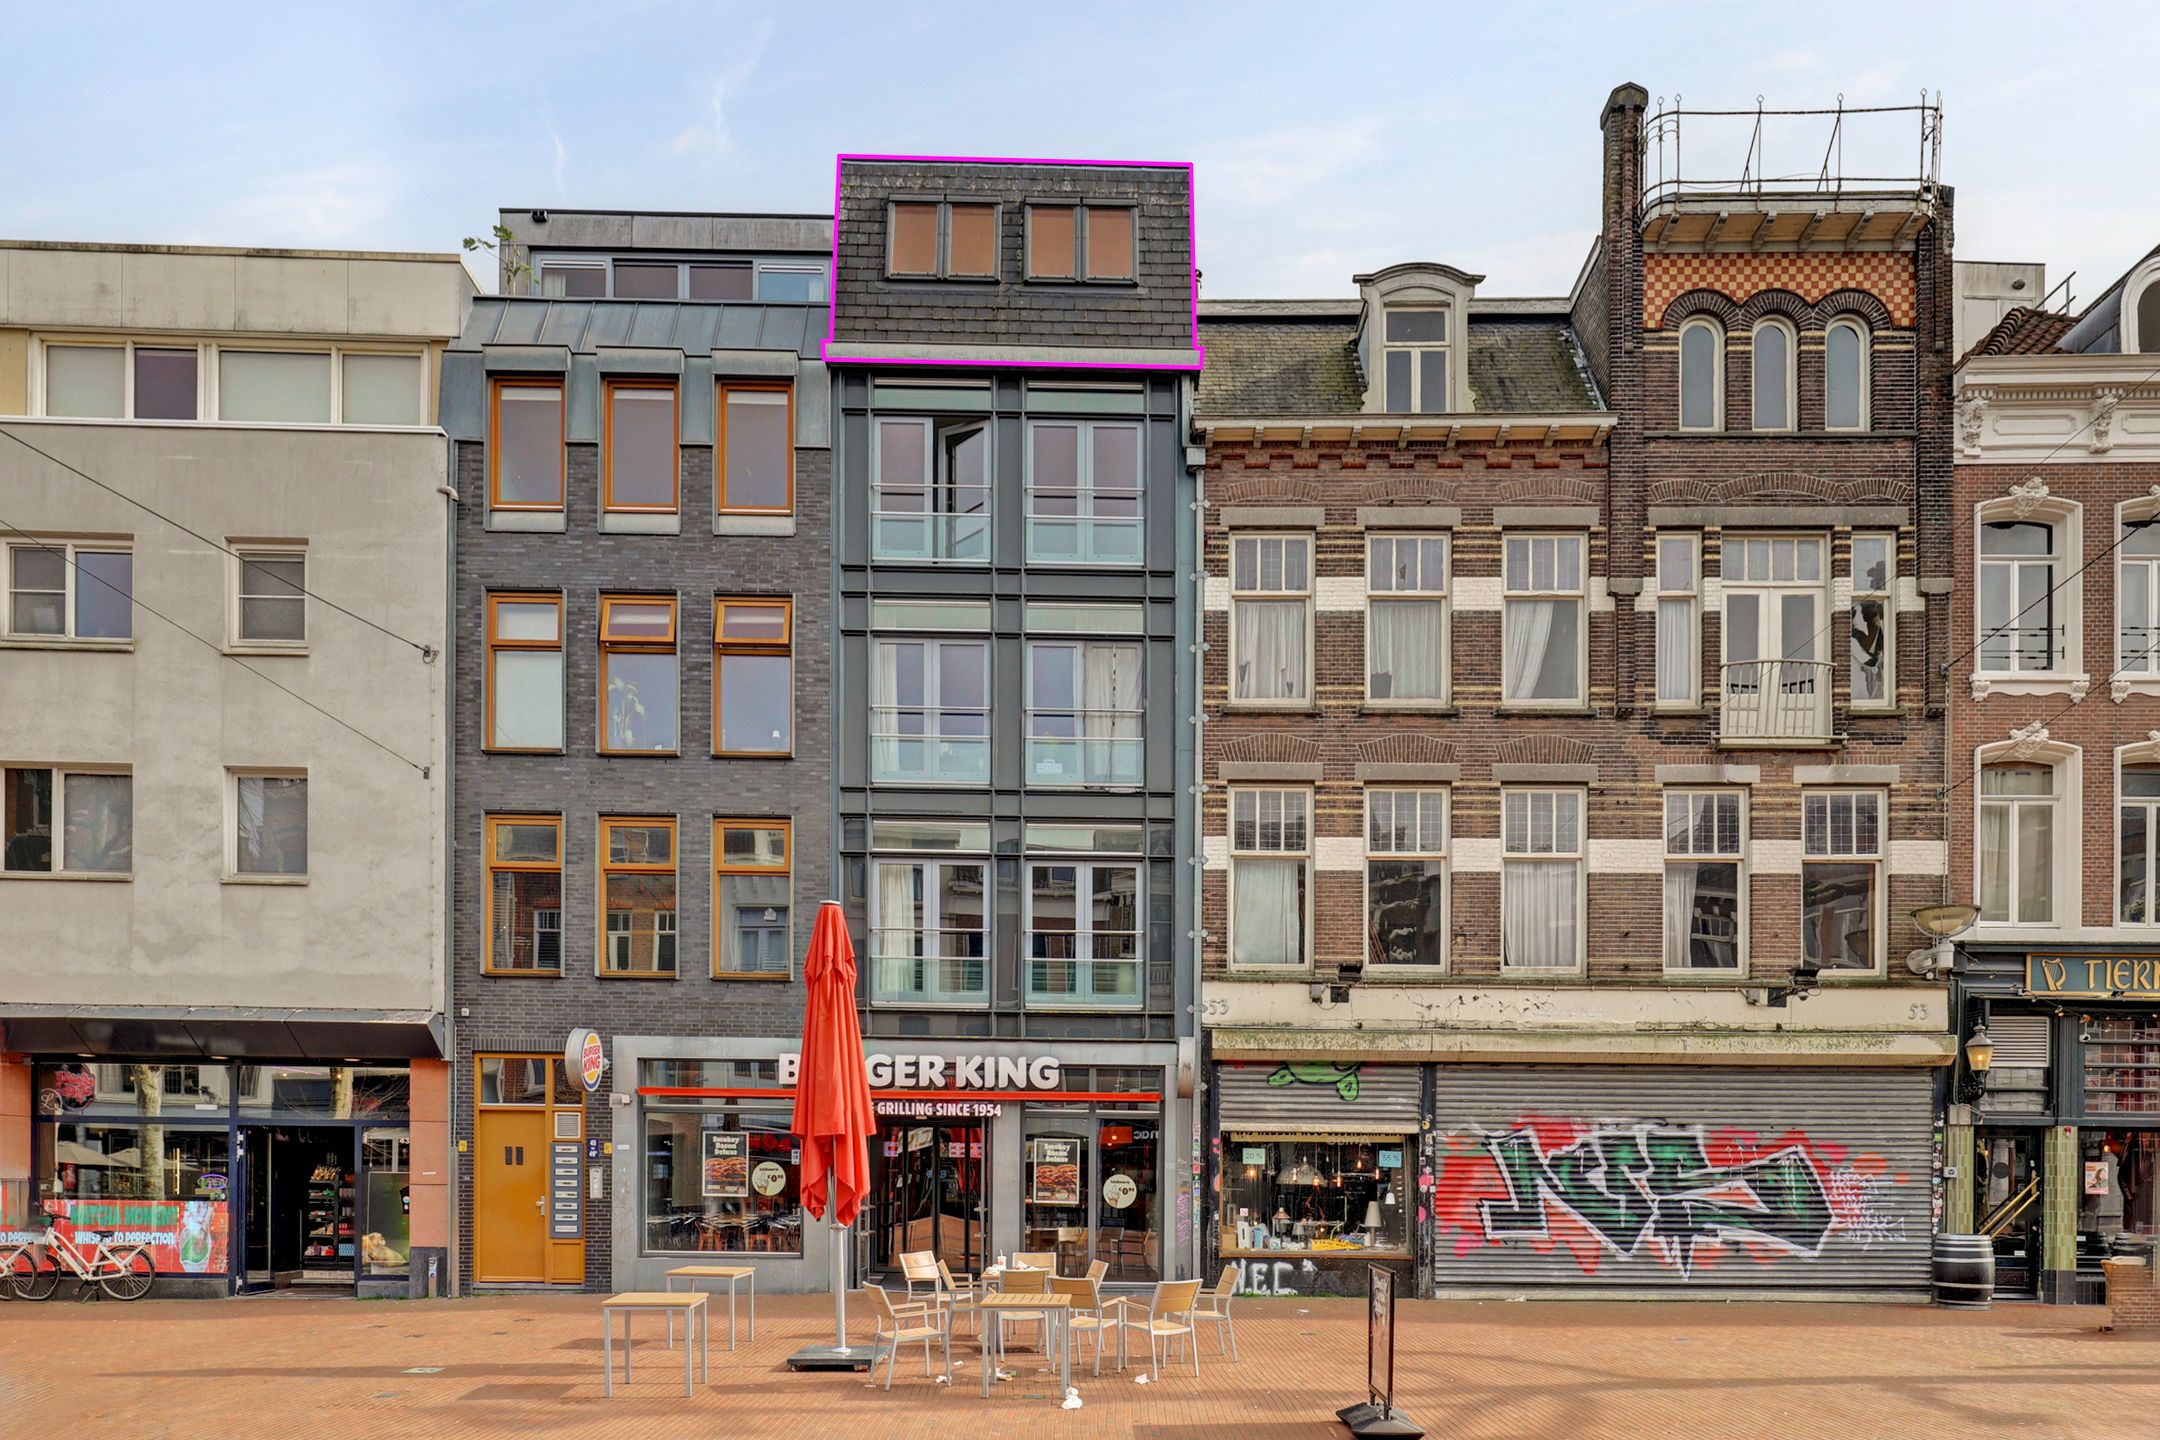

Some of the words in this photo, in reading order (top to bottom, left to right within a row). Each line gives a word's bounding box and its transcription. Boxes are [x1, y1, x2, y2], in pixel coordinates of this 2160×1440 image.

[583, 1044, 600, 1058] BURGER
[583, 1055, 601, 1073] KING
[778, 1053, 947, 1089] BGER
[955, 1055, 1060, 1090] KING
[877, 1102, 933, 1116] GRILLING
[936, 1103, 970, 1117] SINCE
[972, 1103, 1002, 1118] 1954
[713, 1136, 740, 1145] Smokey
[1044, 1143, 1071, 1151] Smokey
[69, 1204, 122, 1226] MATCHA
